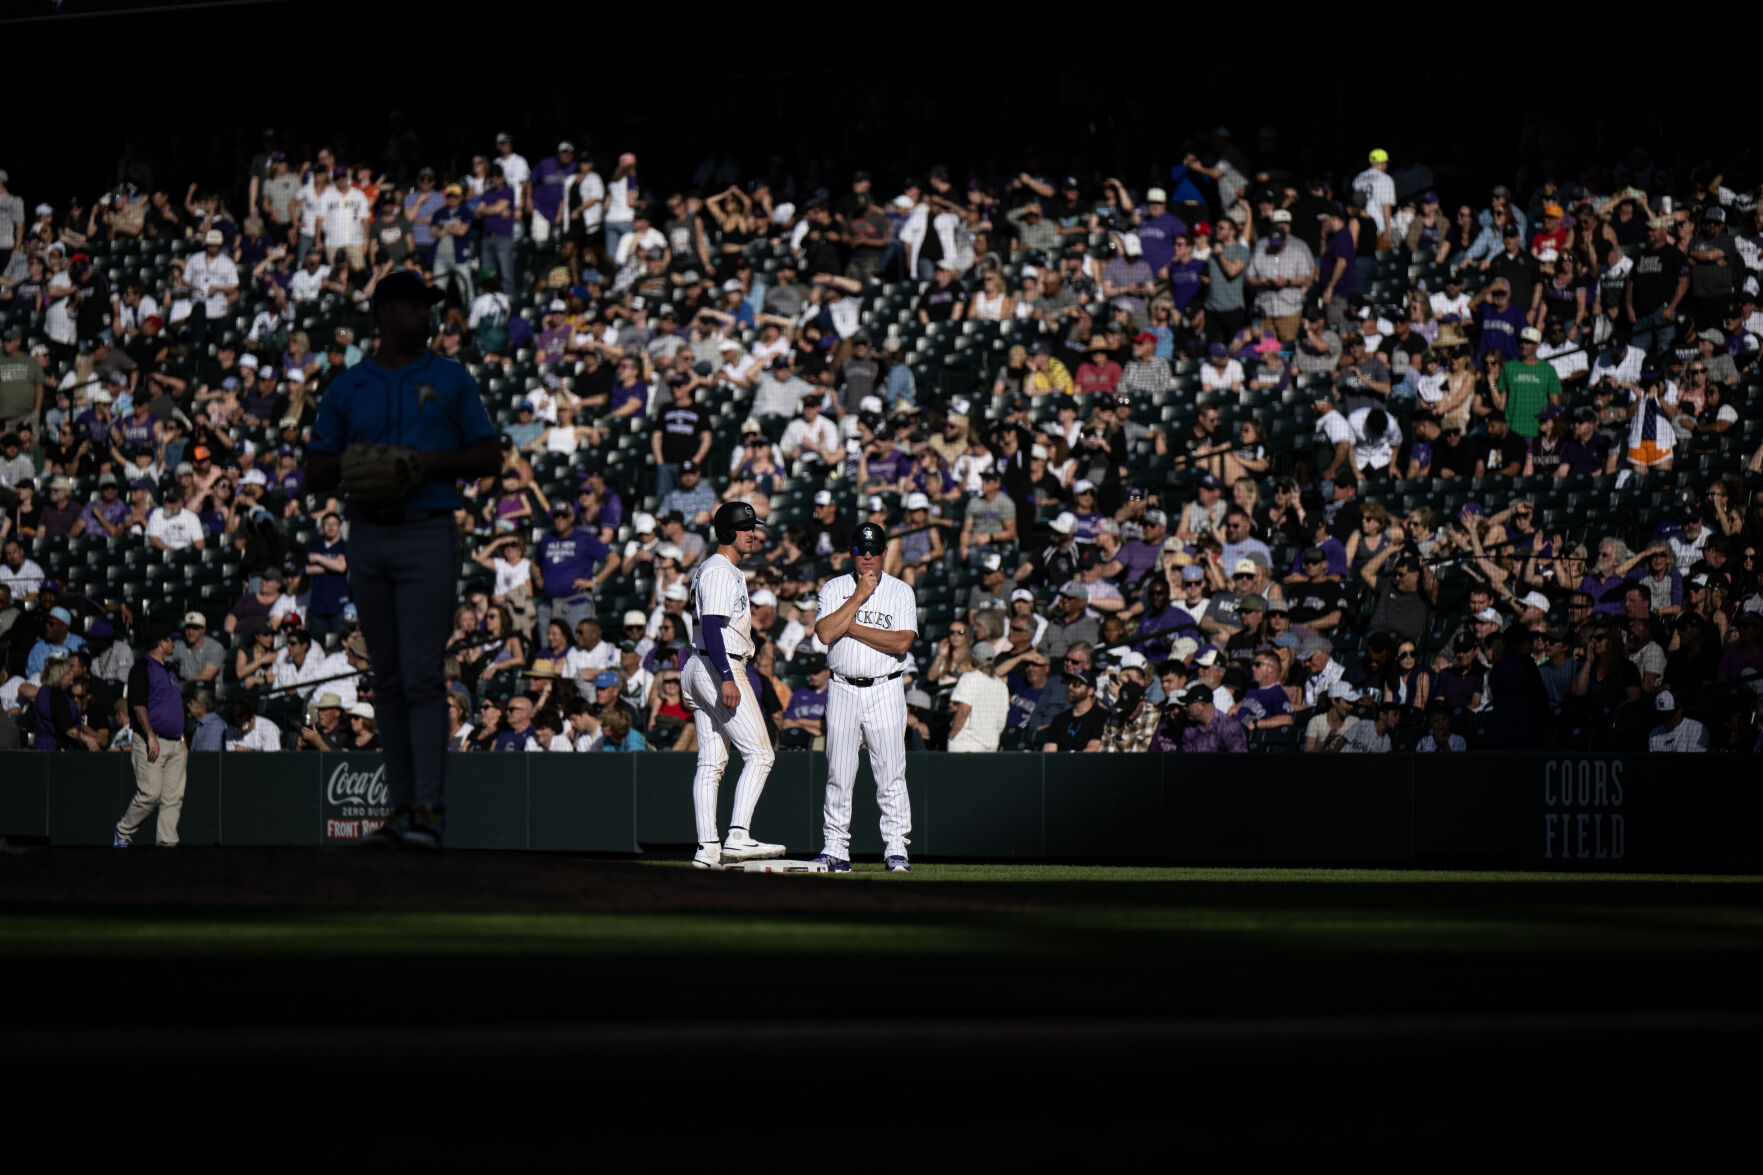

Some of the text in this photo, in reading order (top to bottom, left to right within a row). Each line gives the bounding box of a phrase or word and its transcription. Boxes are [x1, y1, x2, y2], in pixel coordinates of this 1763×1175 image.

[327, 761, 389, 805] Coca-Co
[1545, 759, 1623, 806] COORS
[326, 818, 360, 839] FRONT
[342, 806, 393, 817] ZERO SUGA
[1545, 813, 1624, 858] FIELD
